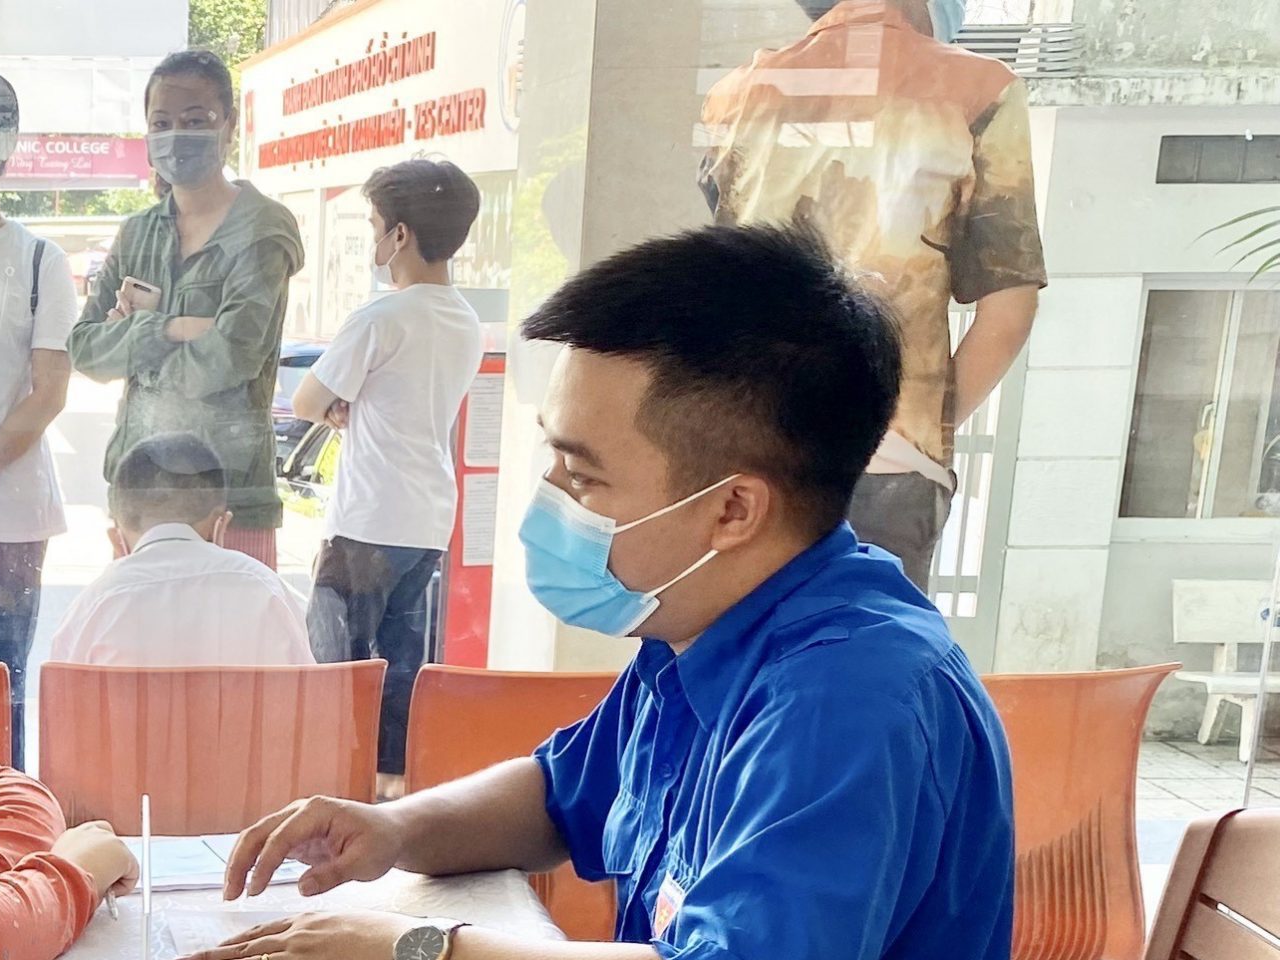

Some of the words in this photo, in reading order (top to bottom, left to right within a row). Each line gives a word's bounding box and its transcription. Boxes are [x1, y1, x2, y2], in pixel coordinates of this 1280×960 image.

[404, 31, 436, 79] MINH
[414, 100, 436, 140] YES
[437, 88, 486, 136] CENTER
[45, 141, 110, 154] COLLEGE
